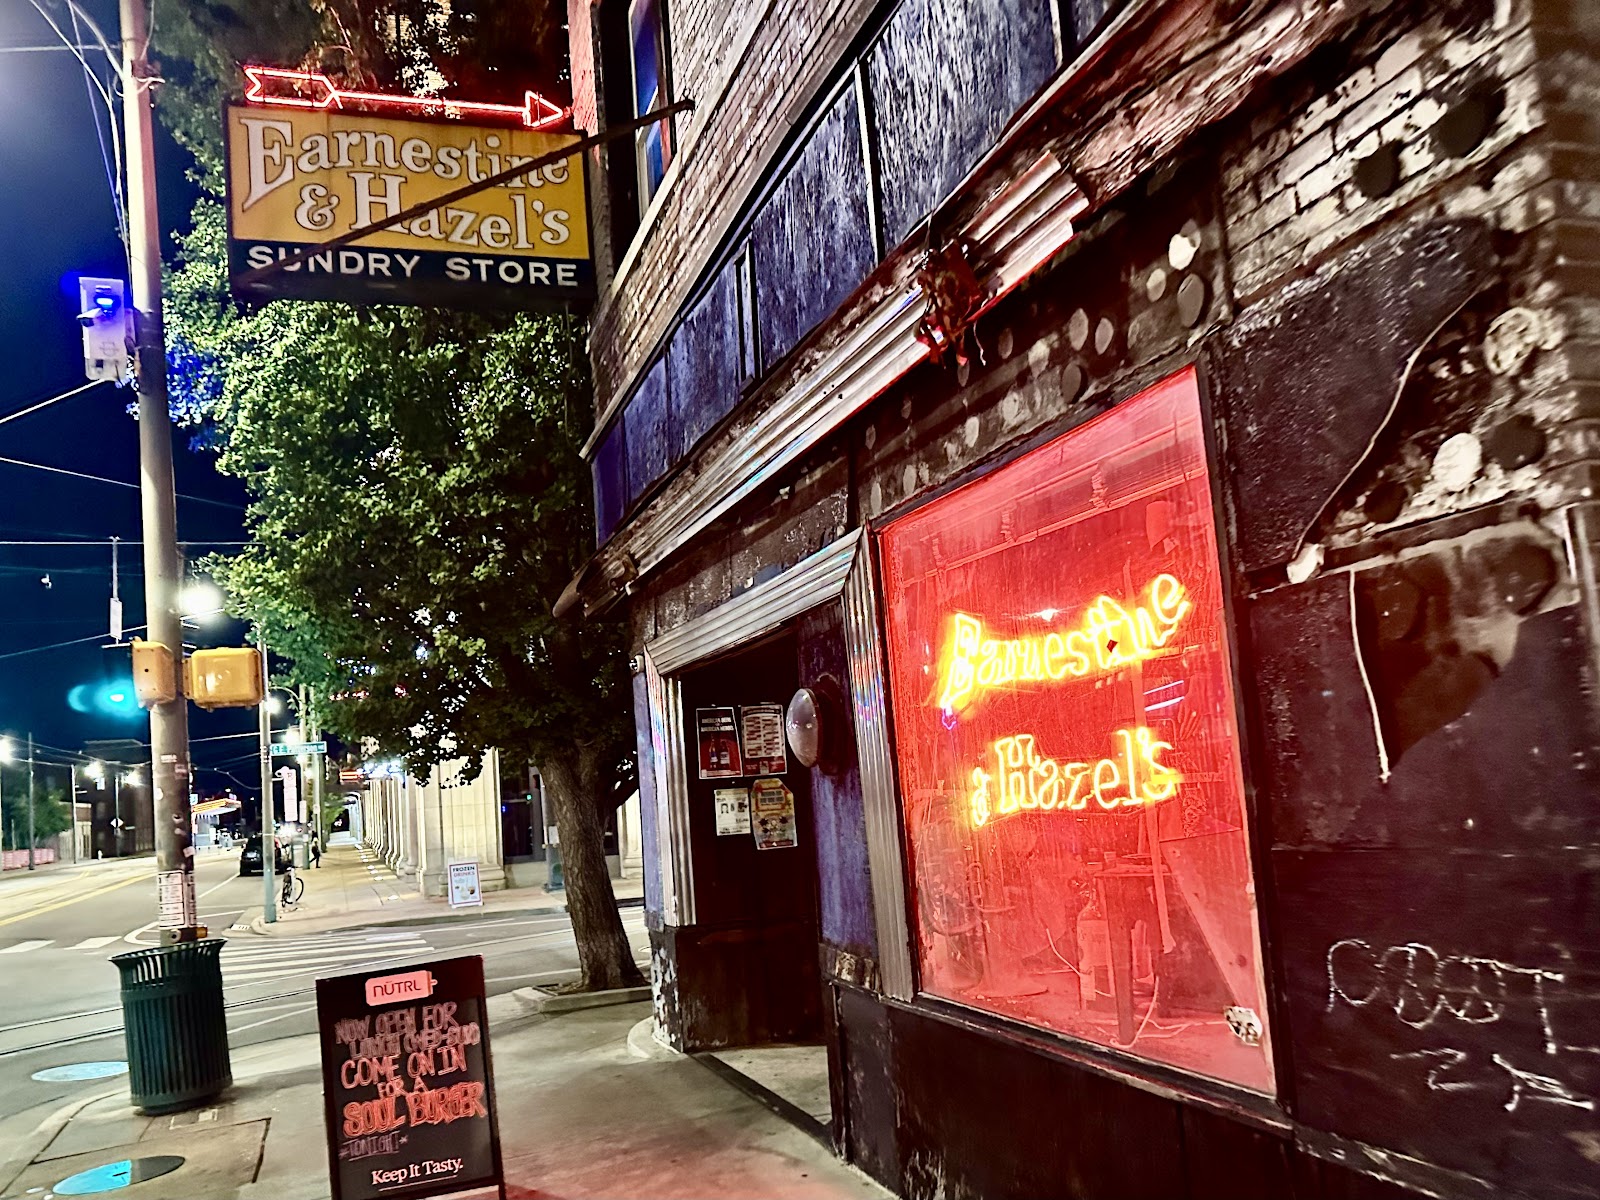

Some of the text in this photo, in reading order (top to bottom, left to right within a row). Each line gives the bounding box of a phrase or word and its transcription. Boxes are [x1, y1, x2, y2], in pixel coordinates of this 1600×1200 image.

[238, 116, 570, 213] Earnestine
[295, 171, 571, 250] & Hazel's
[246, 245, 579, 287] SUNDRY STORE
[335, 1002, 458, 1044] NOW OPEN FOR
[341, 1045, 467, 1089] COME ON IN
[377, 1076, 428, 1098] FOR A
[343, 1082, 487, 1137] SOUL BURGER
[371, 1158, 464, 1185] Keep It Tasty.
